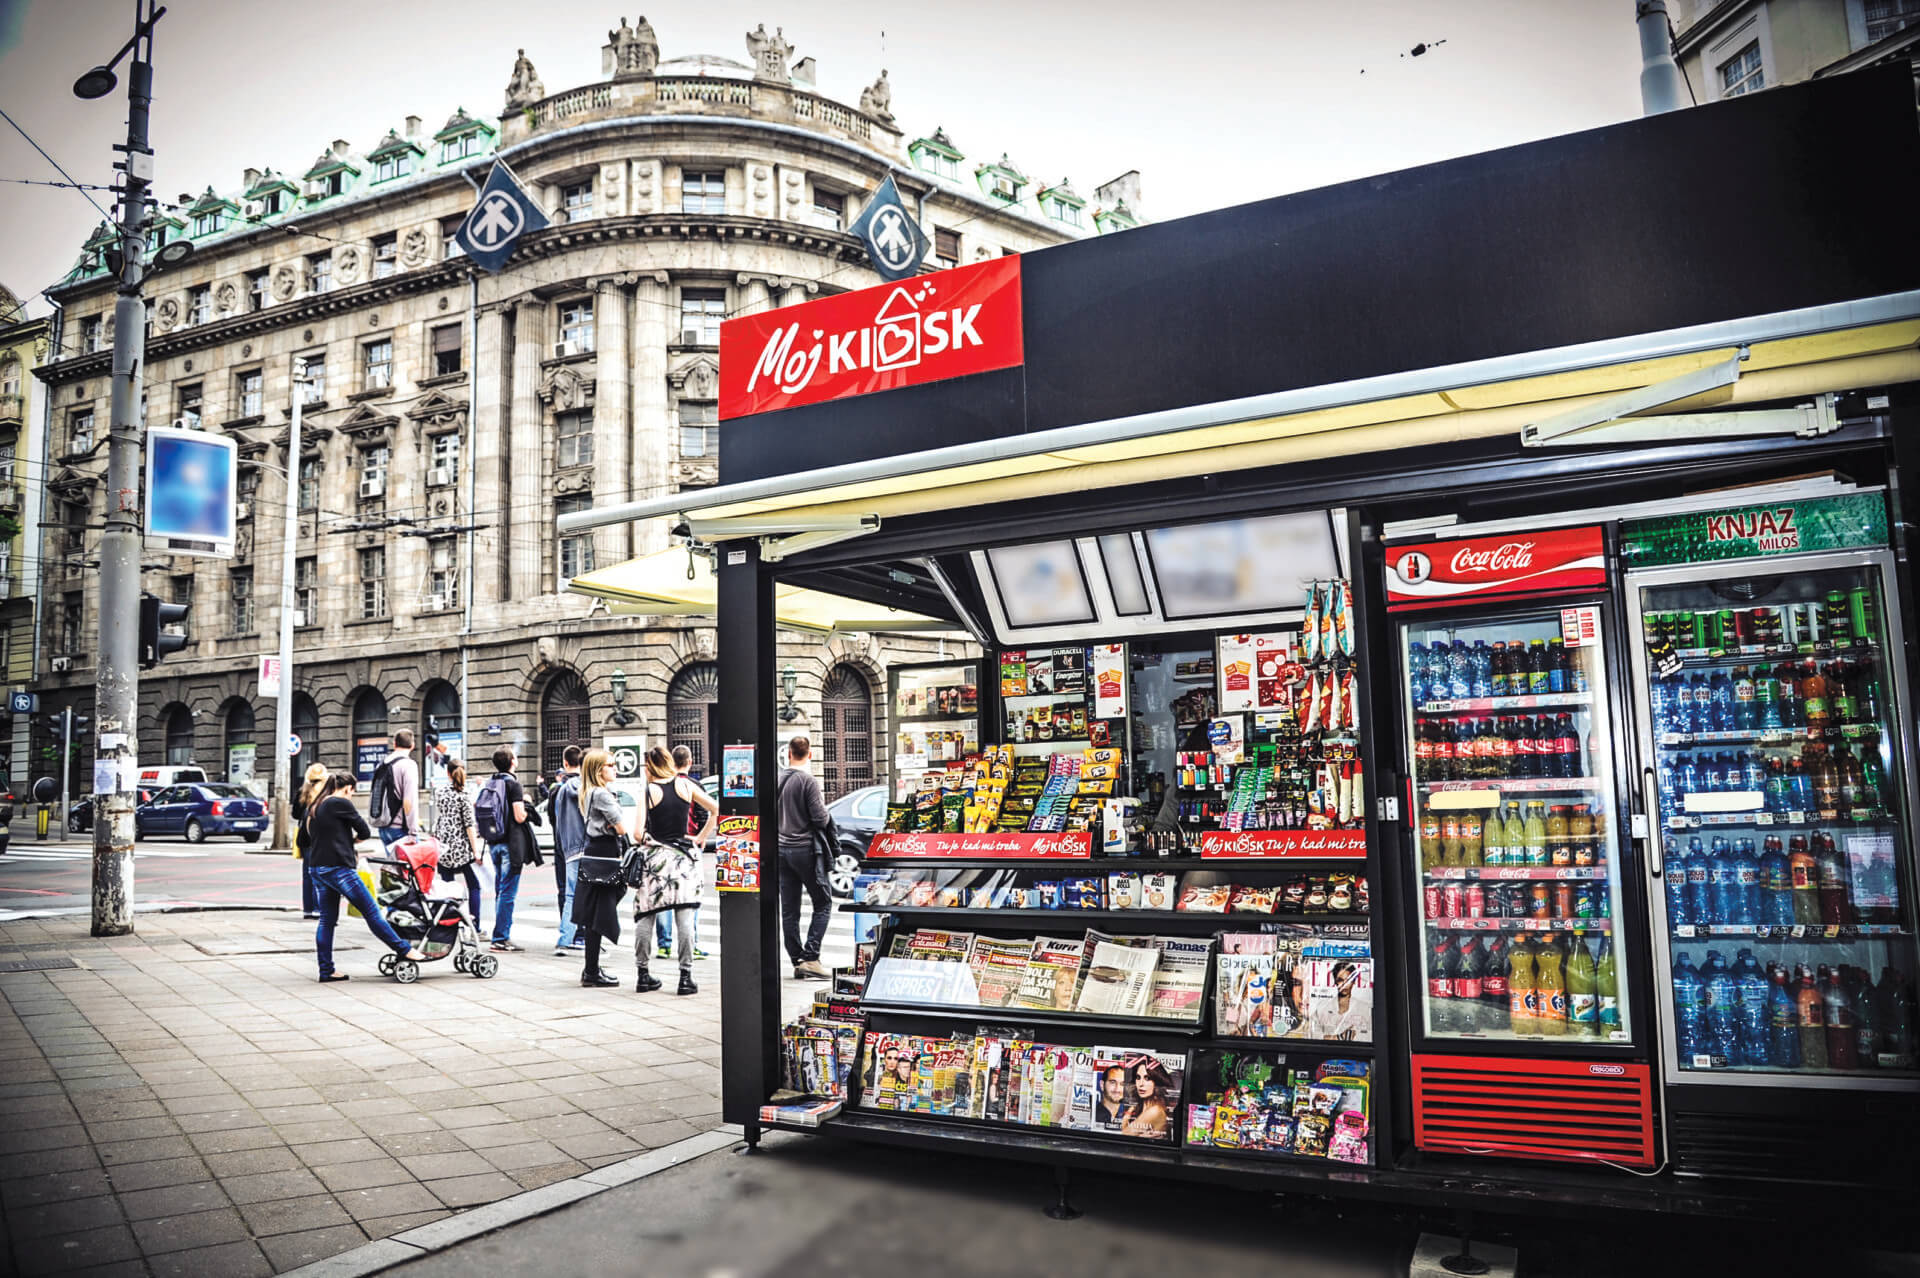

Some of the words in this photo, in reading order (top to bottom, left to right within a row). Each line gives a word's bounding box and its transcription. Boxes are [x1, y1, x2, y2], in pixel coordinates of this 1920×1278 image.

[747, 323, 823, 394] Moj
[829, 287, 983, 374] KIOSK
[1706, 508, 1797, 542] KNJAZ
[1759, 534, 1799, 550] MILOŠ
[1451, 541, 1537, 574] Coca-Cola
[719, 816, 757, 834] AKCIJA!
[877, 838, 896, 853] Moj
[895, 835, 927, 853] KIOSK
[949, 840, 959, 854] je
[961, 839, 980, 850] kad
[981, 840, 995, 851] mi
[1030, 838, 1051, 854] Moj
[1050, 834, 1086, 853] KIOSK
[1203, 838, 1223, 855] Moj
[1223, 833, 1265, 853] KIOSK
[1266, 838, 1282, 850] Tu
[1282, 840, 1296, 855] je
[1300, 836, 1326, 850] kad
[1328, 839, 1348, 850] mi
[1046, 940, 1079, 952] Kurir
[1166, 940, 1207, 953] Danas
[1026, 967, 1054, 978] BOLJE
[1020, 985, 1051, 999] UMRLA
[1023, 977, 1036, 986] DA
[1036, 978, 1057, 989] SAM
